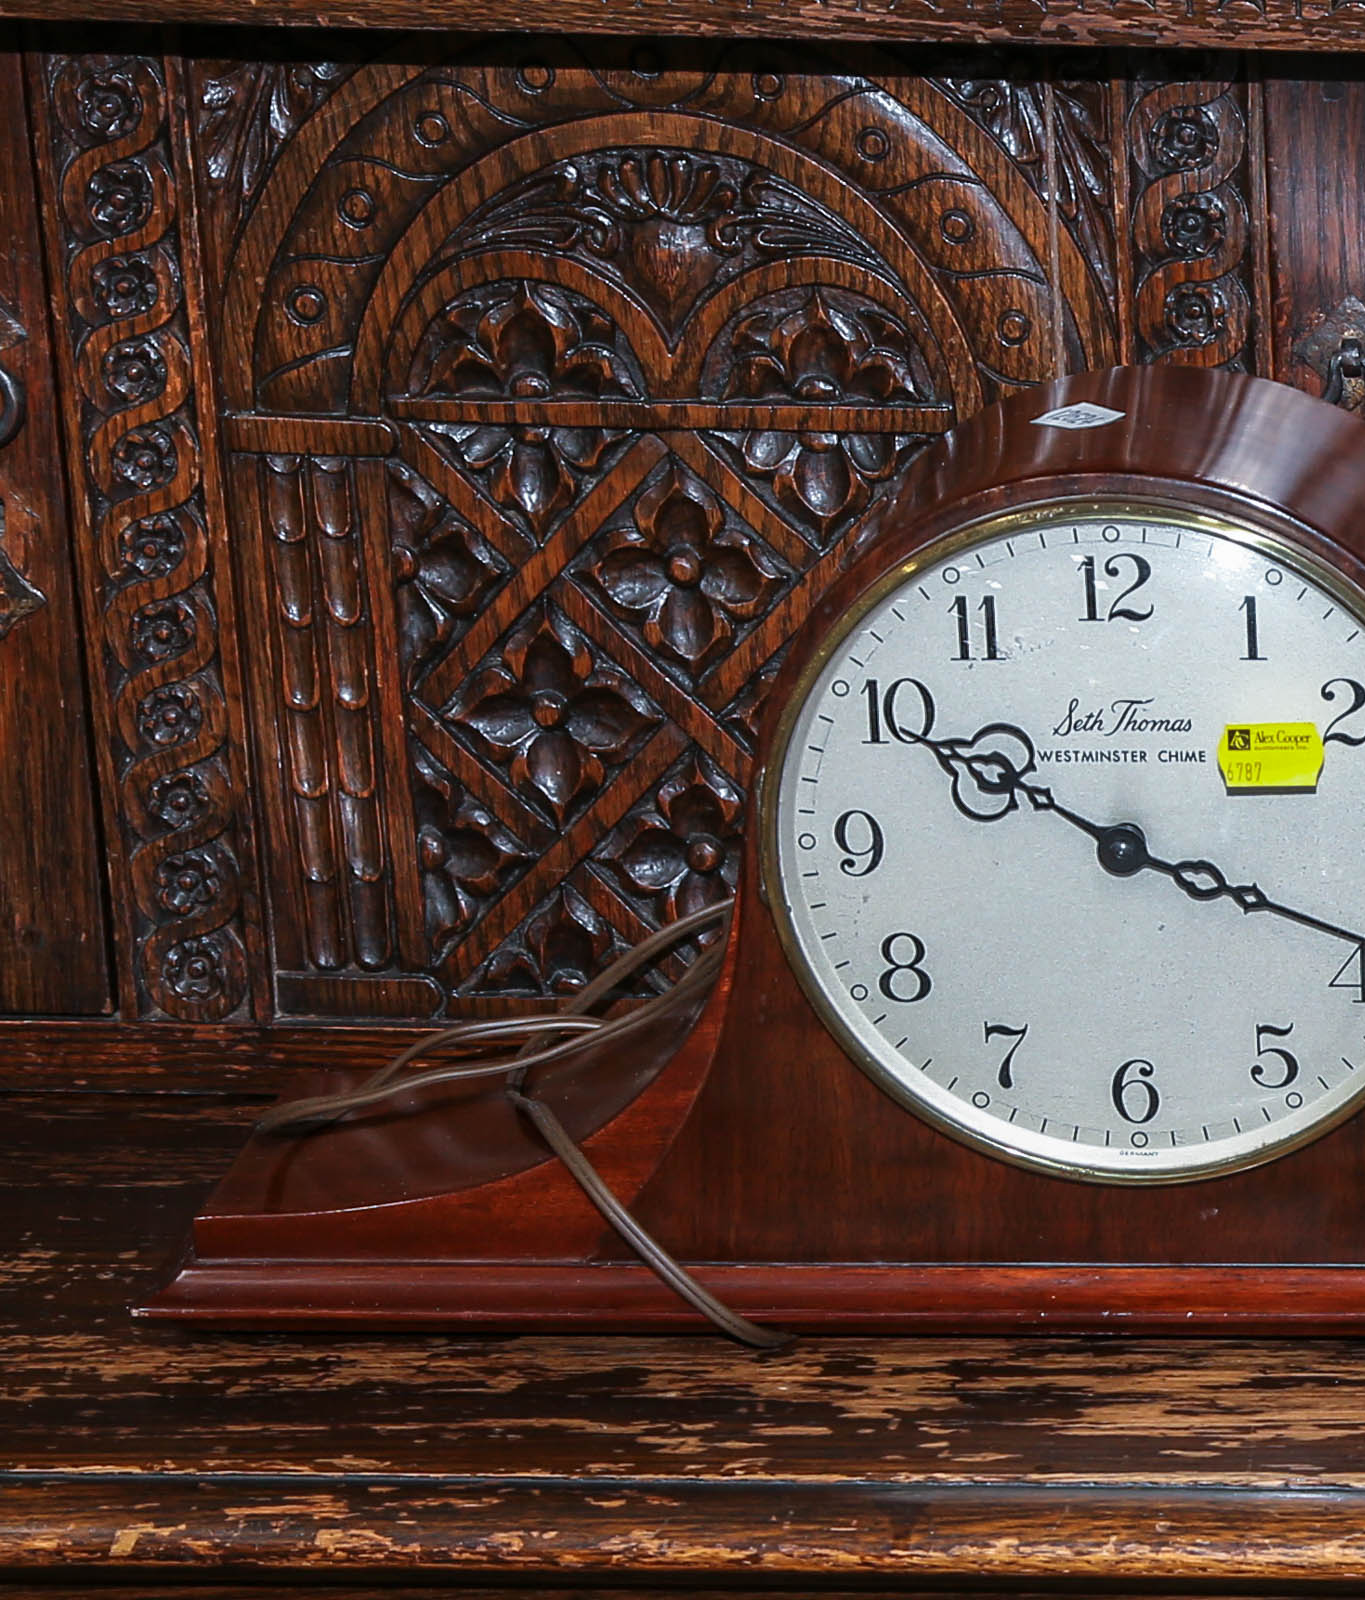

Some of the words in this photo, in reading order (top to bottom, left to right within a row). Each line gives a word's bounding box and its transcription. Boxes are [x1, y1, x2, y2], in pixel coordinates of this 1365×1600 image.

[1077, 553, 1154, 621] 12
[949, 596, 1006, 660] 11
[1240, 596, 1267, 660] 1
[860, 679, 935, 744] 10
[1053, 698, 1103, 736] Seth
[1104, 698, 1192, 736] Thomas
[1254, 730, 1274, 743] Alex
[1277, 730, 1311, 746] Cooper
[1037, 750, 1147, 762] WESTMINSTER
[1158, 750, 1206, 762] CHIME
[1227, 762, 1262, 782] 6787
[834, 811, 884, 877] 9
[878, 933, 932, 1003] 8
[984, 1023, 1028, 1088] 7
[1251, 1022, 1299, 1090] 5
[1111, 1060, 1160, 1124] 6
